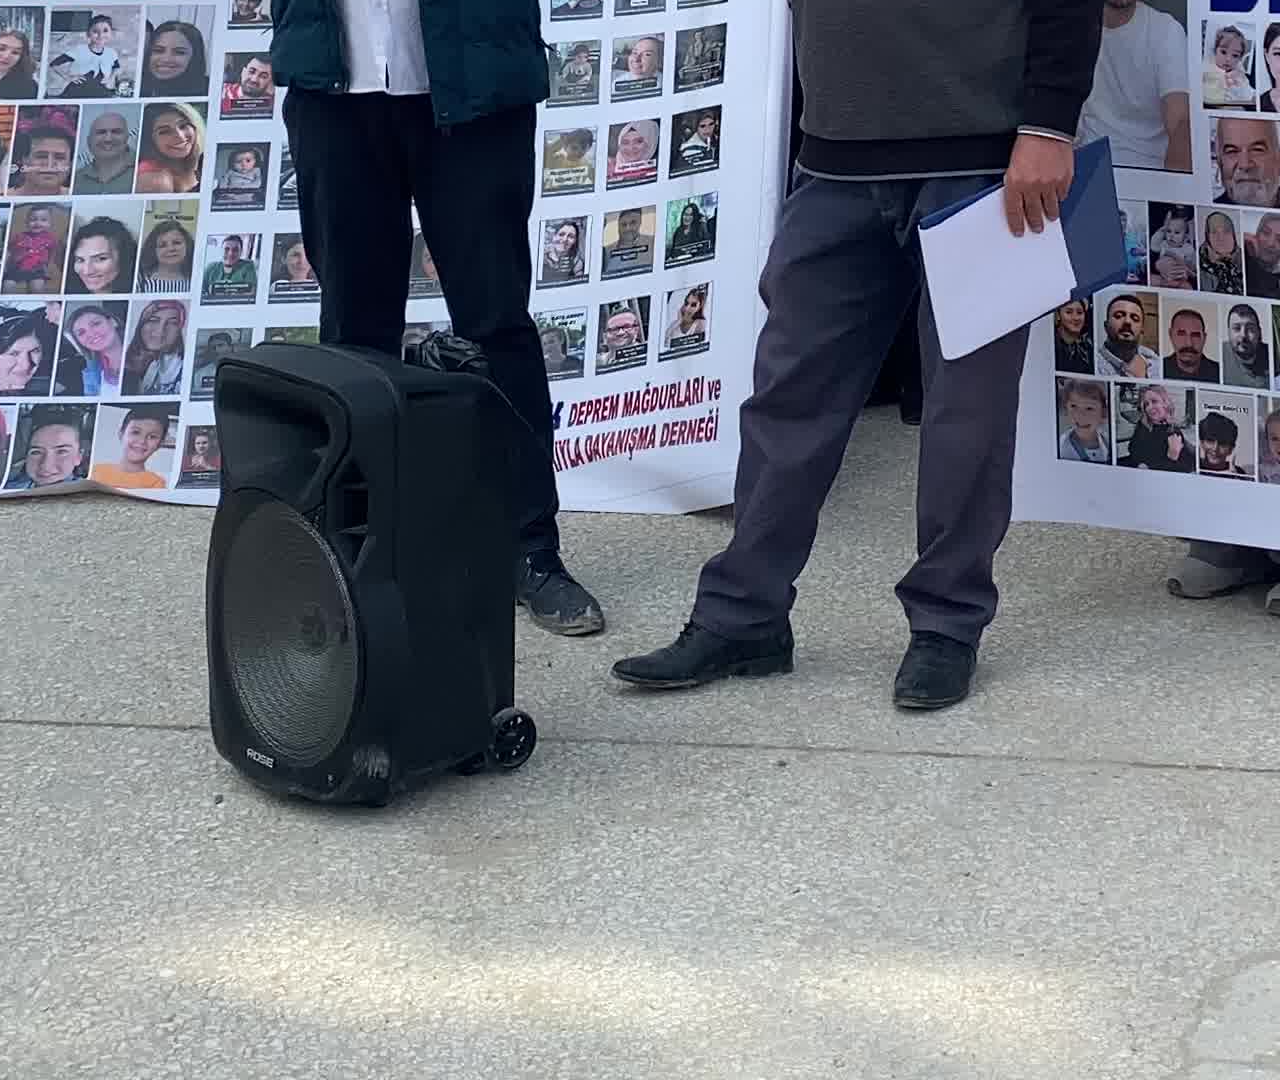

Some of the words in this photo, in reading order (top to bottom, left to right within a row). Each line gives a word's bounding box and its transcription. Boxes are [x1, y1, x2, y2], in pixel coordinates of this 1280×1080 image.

[567, 394, 620, 428] DEPREM
[621, 375, 705, 419] MAĞDURLARI
[707, 378, 722, 402] ve
[584, 423, 657, 461] DAYANIŞMA
[659, 407, 719, 448] DERNEĞİ
